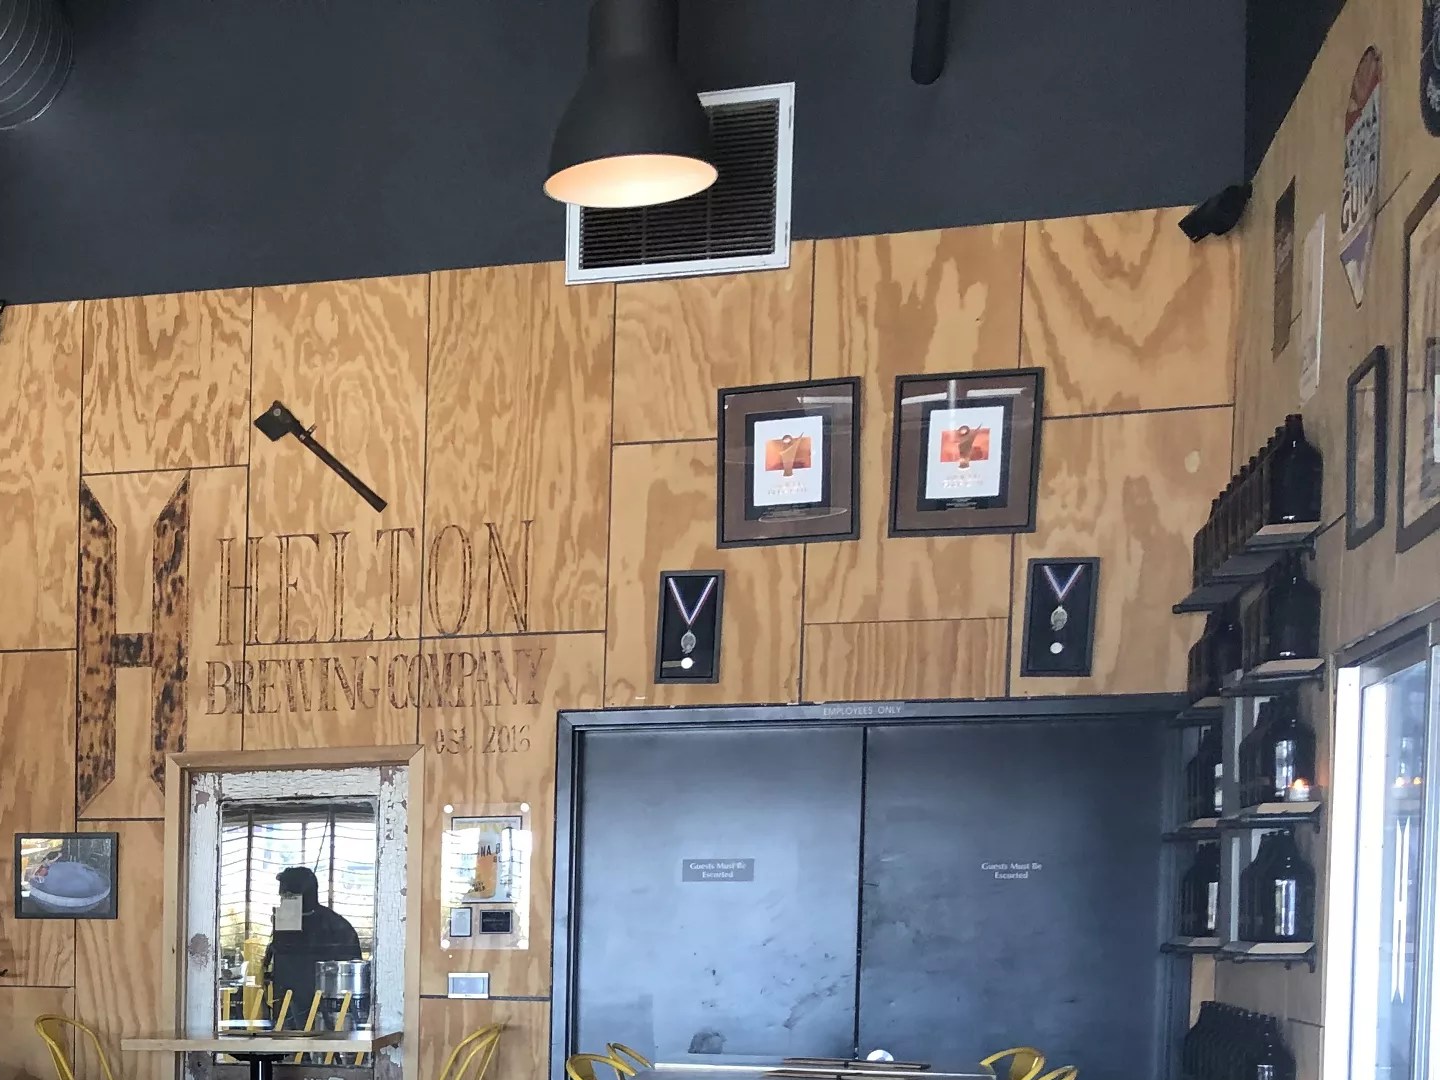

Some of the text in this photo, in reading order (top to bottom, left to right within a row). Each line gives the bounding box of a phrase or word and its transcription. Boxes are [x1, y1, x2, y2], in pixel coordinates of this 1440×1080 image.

[215, 520, 535, 646] HELTON
[204, 647, 548, 716] BREWING COMPANY
[823, 705, 903, 716] EMPLOYEES ONLY
[481, 724, 533, 756] 2016
